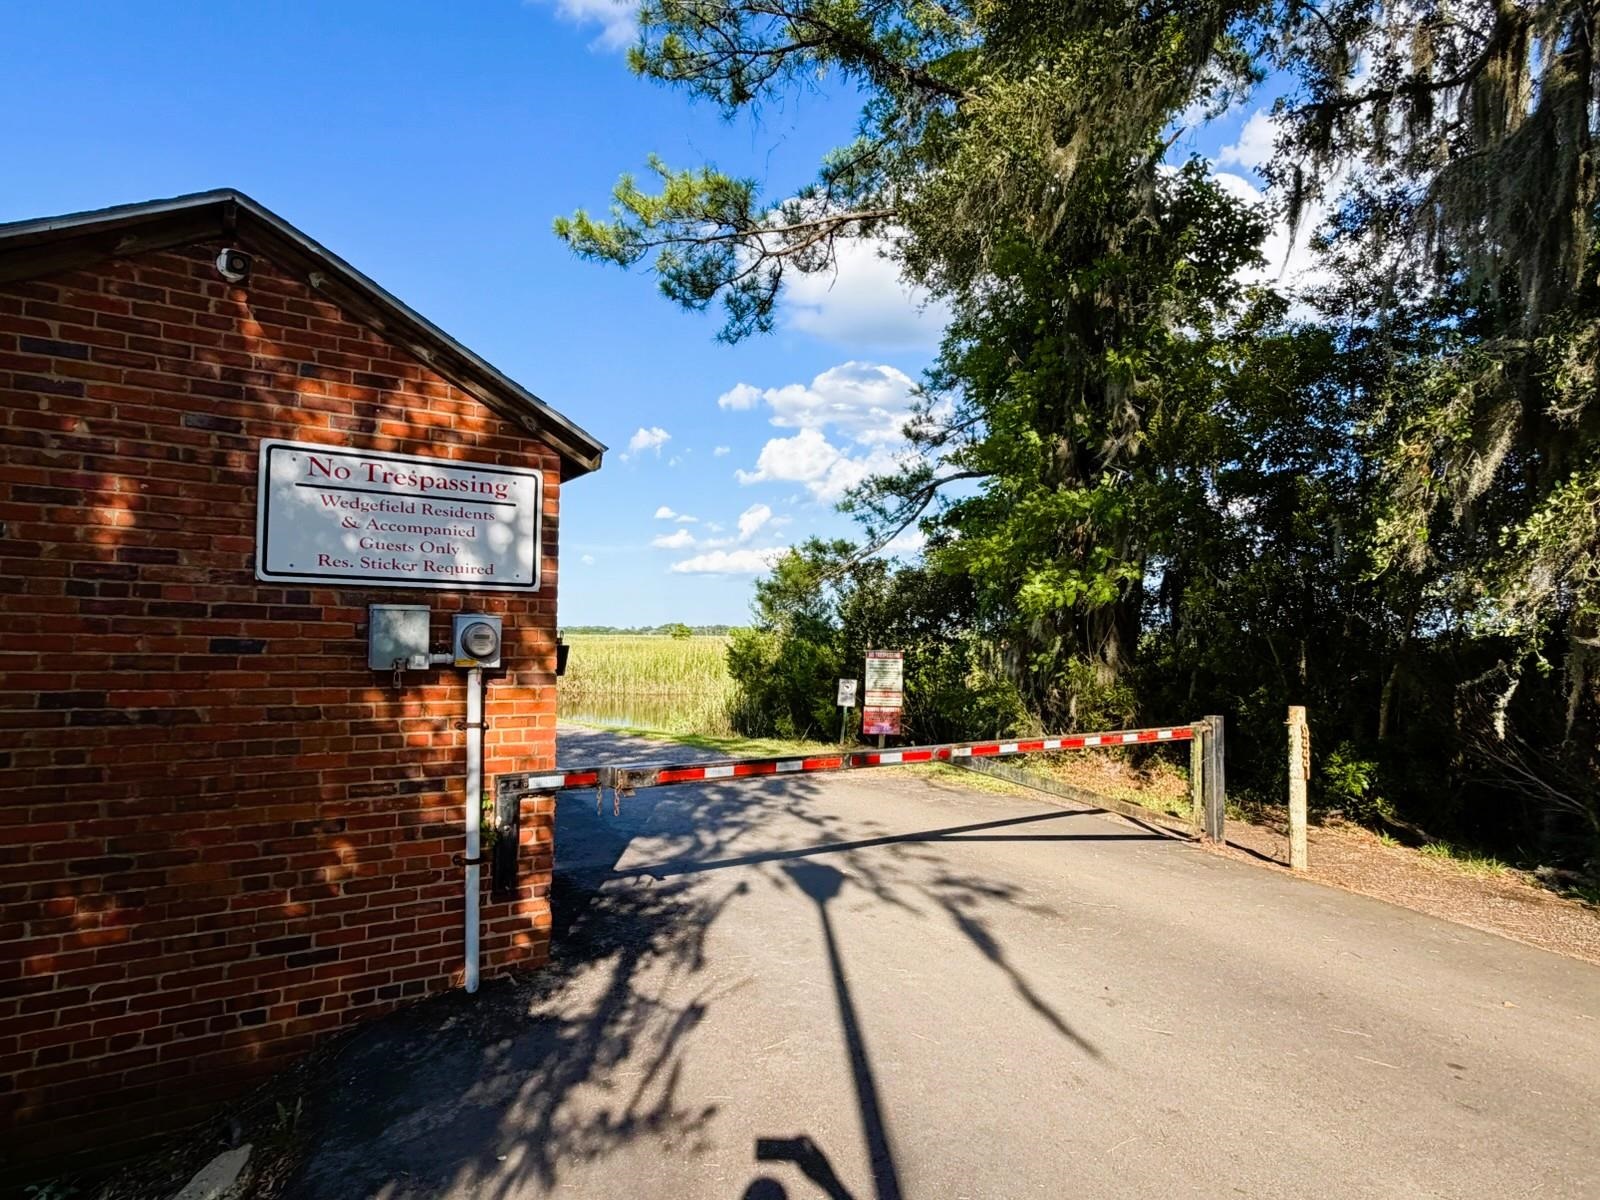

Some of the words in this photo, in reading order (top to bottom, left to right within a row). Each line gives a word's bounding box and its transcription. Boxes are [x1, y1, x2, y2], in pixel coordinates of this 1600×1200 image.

[307, 456, 351, 480] No
[360, 462, 509, 499] Trespassing
[320, 494, 415, 514] Wedgefield
[422, 506, 496, 521] Residents
[341, 516, 360, 529] &
[366, 520, 475, 538] Accompanied
[360, 537, 414, 552] Guests
[420, 542, 459, 556] Only
[317, 554, 354, 568] Res.
[360, 557, 418, 571] Sticker
[424, 560, 494, 576] Required
